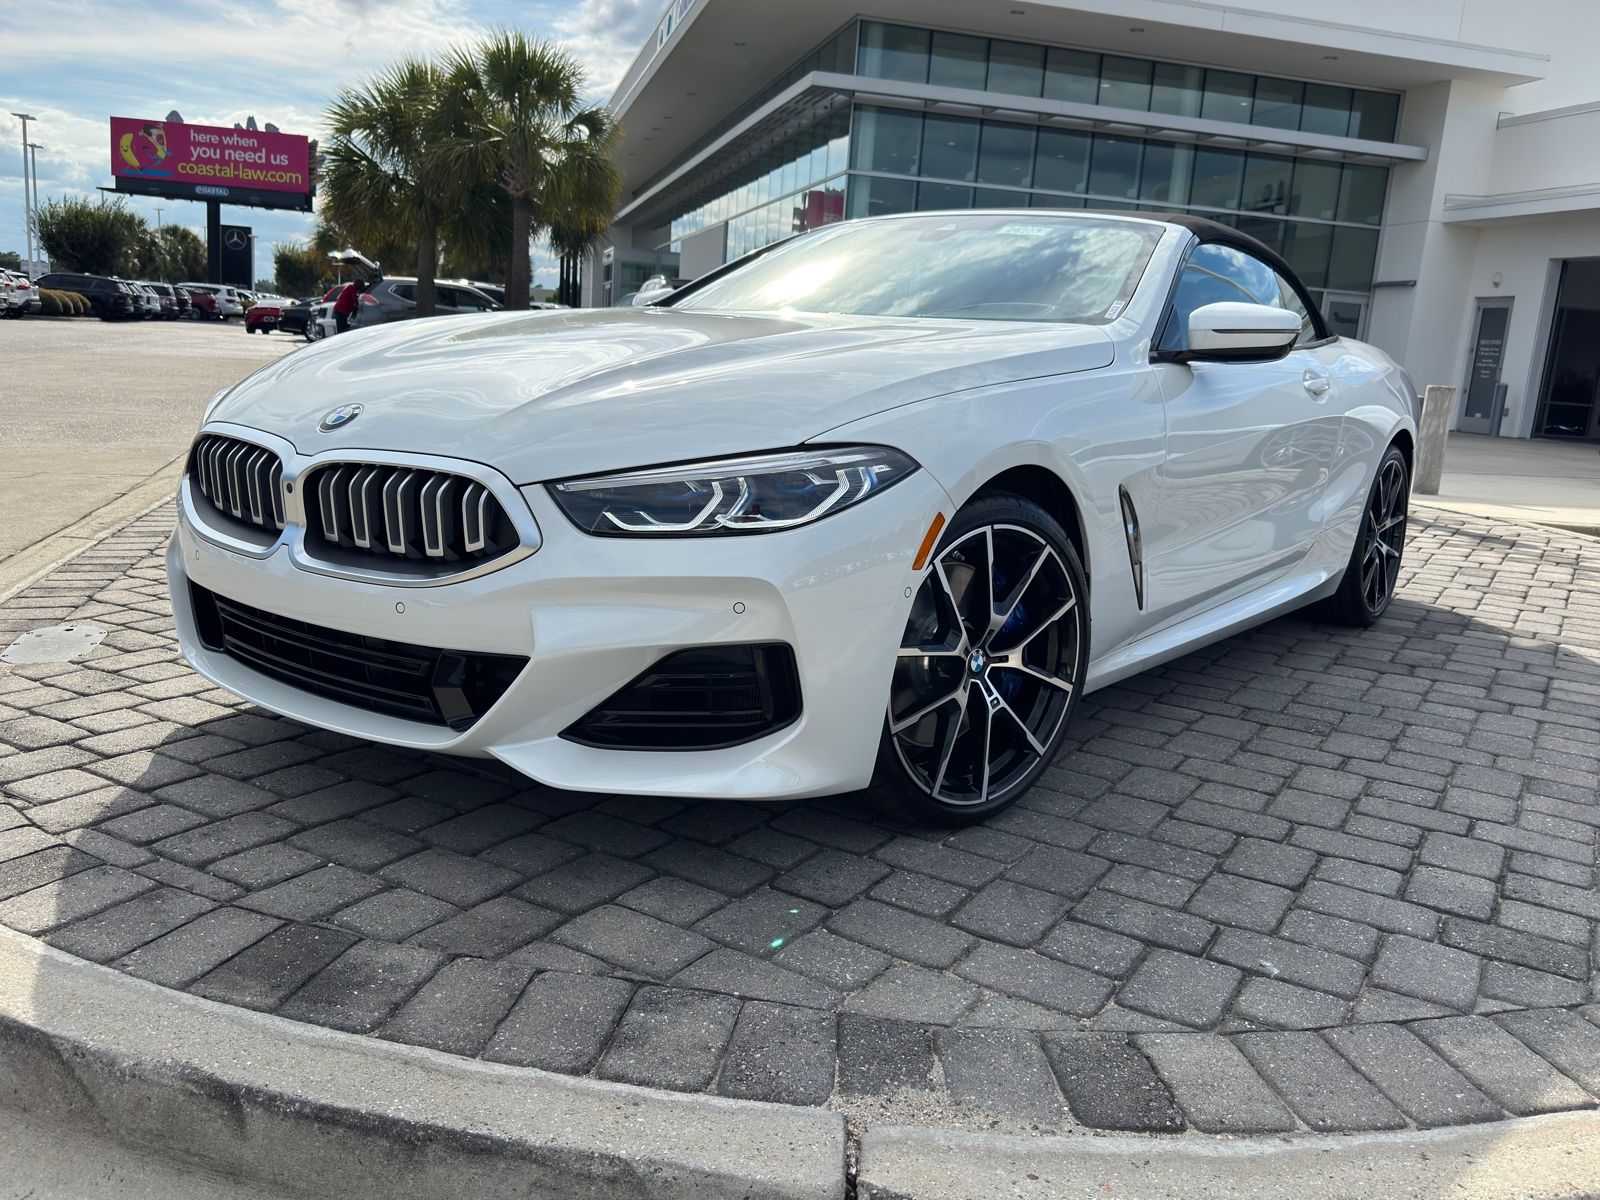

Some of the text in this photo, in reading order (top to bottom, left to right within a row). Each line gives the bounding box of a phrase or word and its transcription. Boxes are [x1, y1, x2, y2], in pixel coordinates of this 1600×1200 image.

[190, 129, 258, 148] here when
[190, 146, 289, 166] you need us
[178, 161, 302, 184] coastal-law.com
